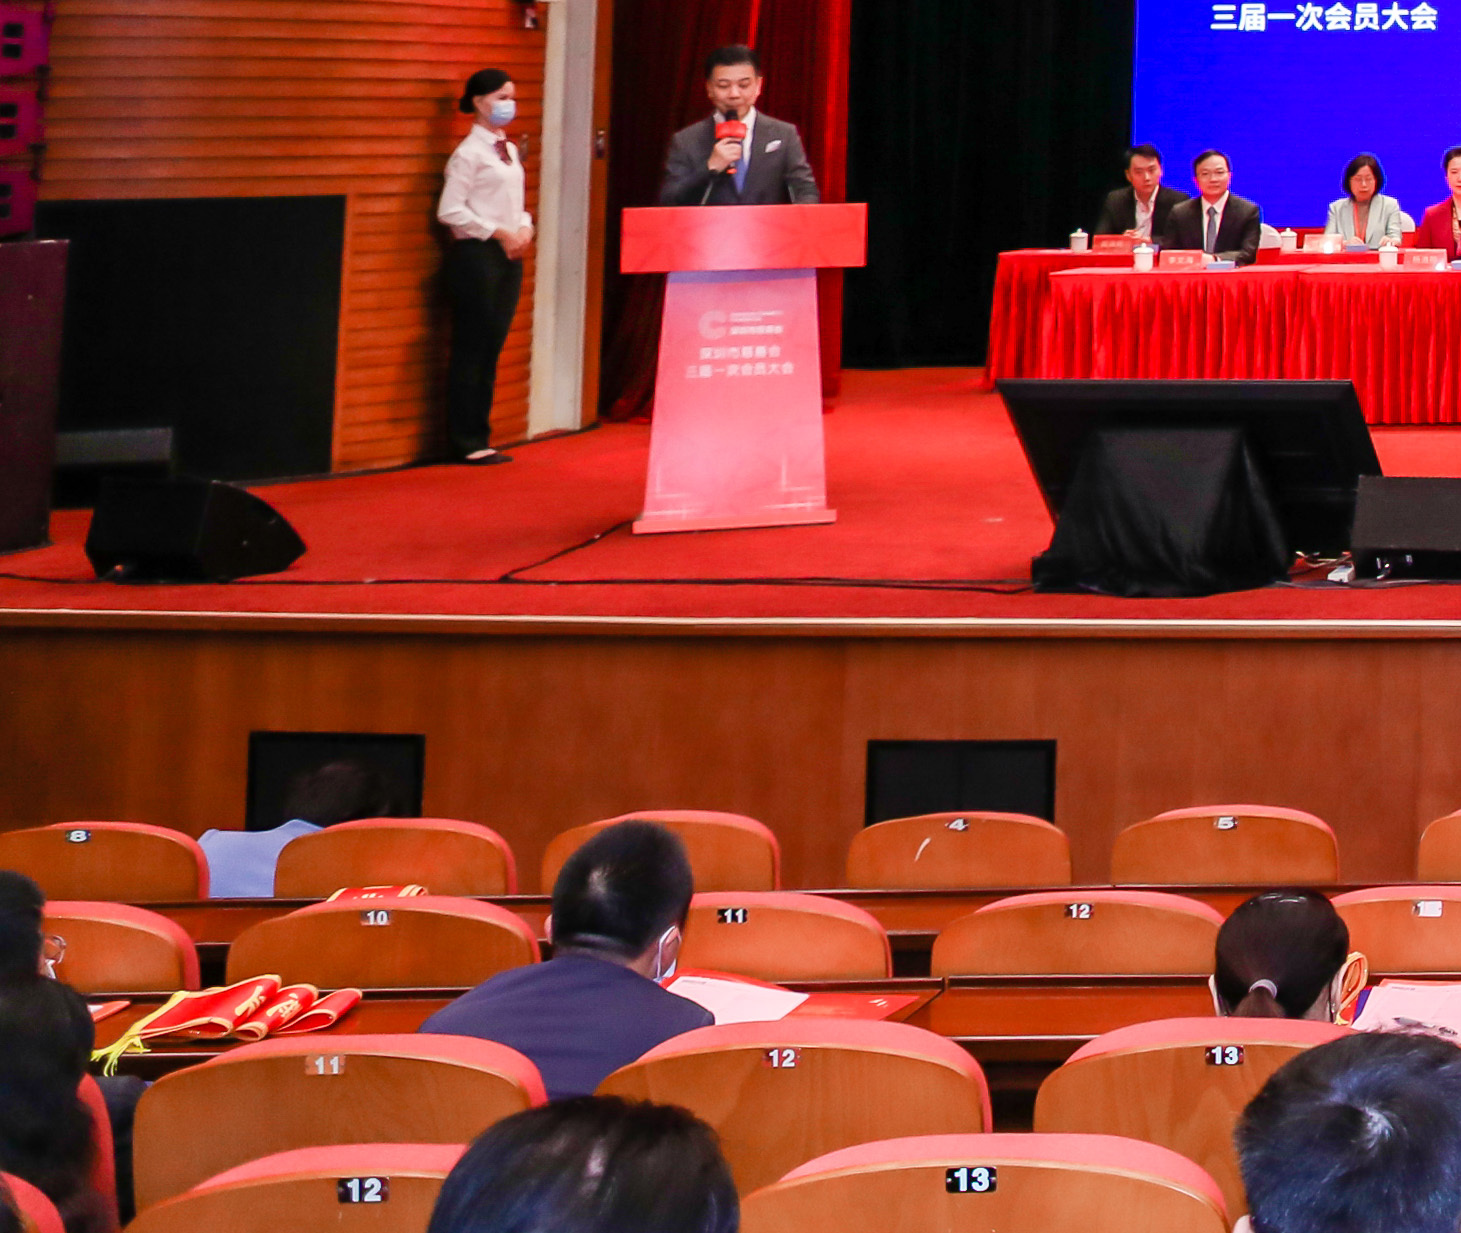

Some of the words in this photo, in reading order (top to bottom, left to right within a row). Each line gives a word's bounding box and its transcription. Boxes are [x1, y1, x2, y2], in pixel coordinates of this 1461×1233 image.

[1210, 1, 1438, 32] 三届一次会员大会
[949, 818, 966, 831] 4
[1217, 817, 1236, 830] 5
[69, 830, 87, 843] 8
[366, 910, 388, 925] 10
[724, 908, 744, 923] 11
[1069, 904, 1091, 919] 12
[769, 1049, 796, 1067] 12
[1212, 1046, 1239, 1065] 13
[315, 1056, 339, 1074] 11
[953, 1167, 990, 1192] 13
[347, 1178, 382, 1202] 12
